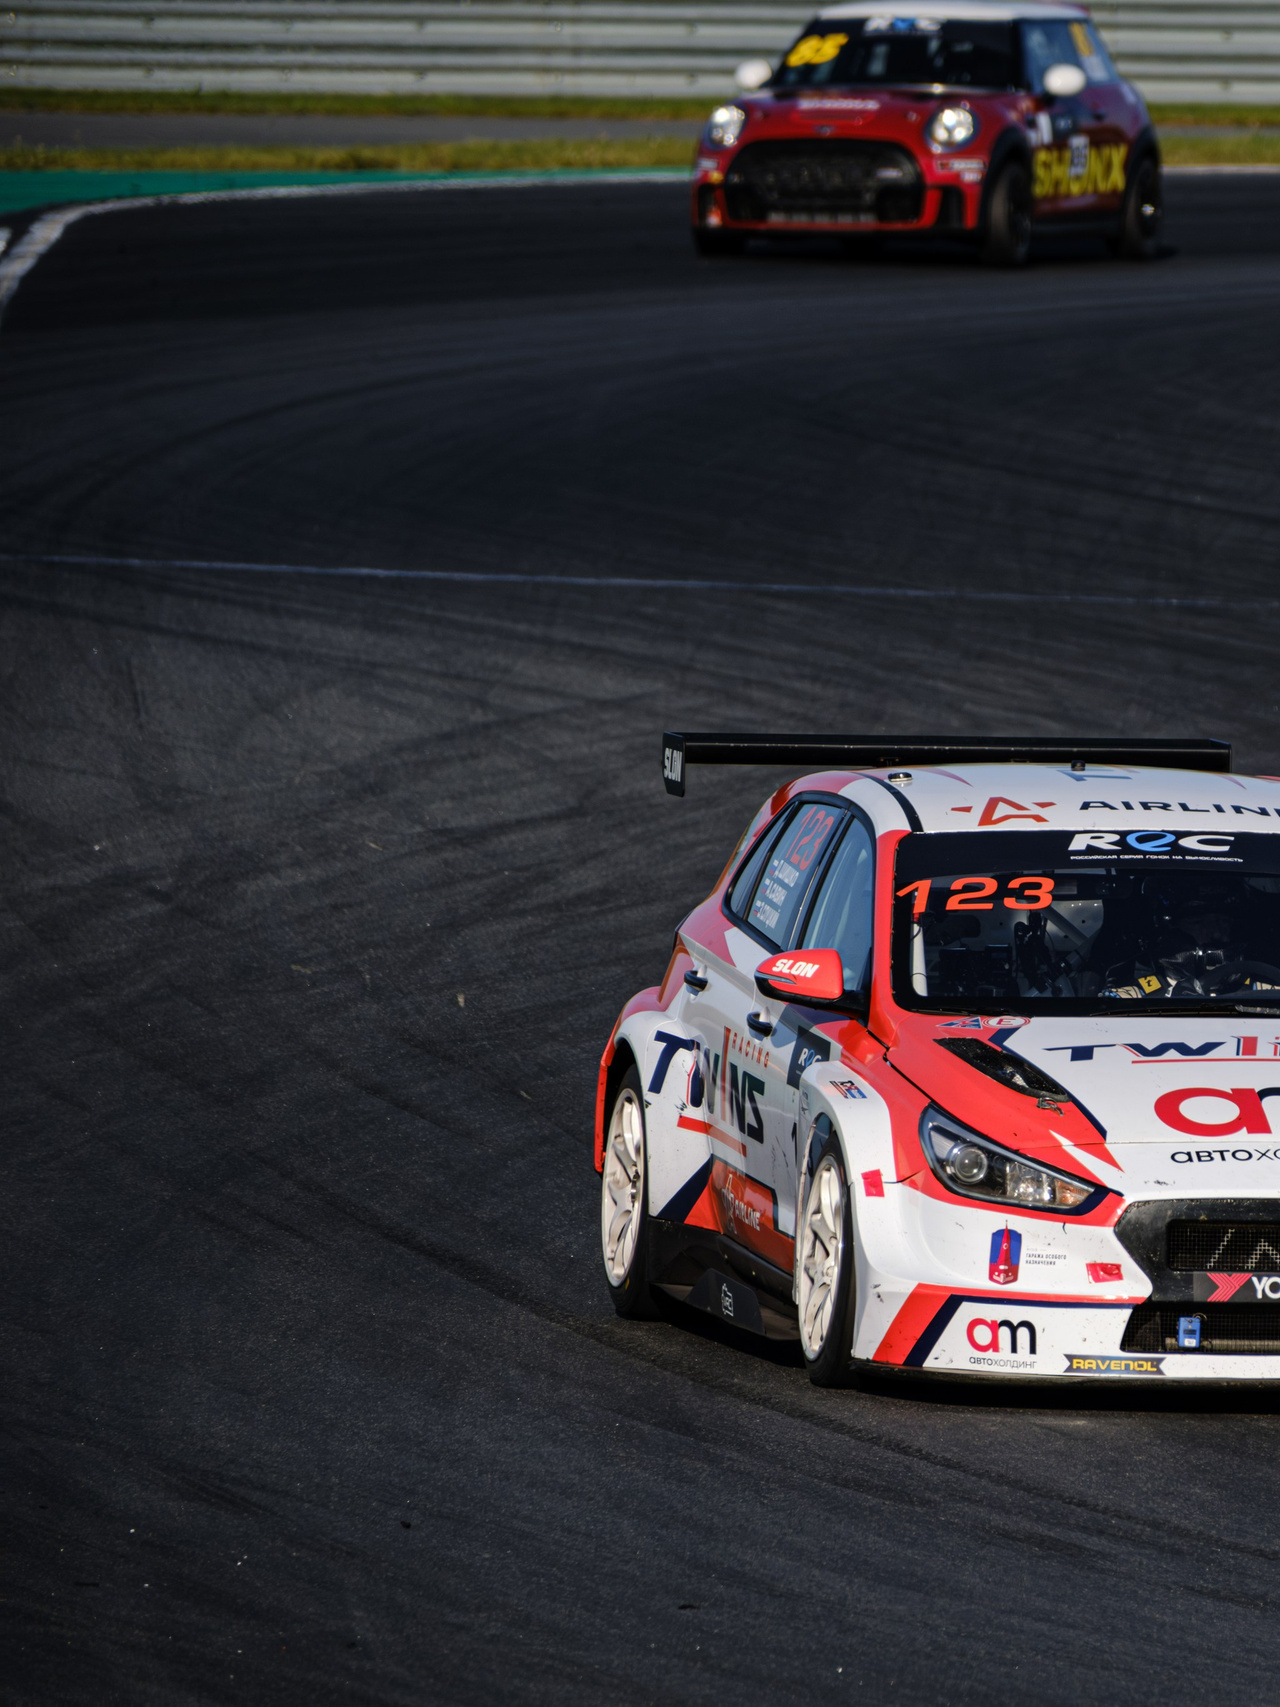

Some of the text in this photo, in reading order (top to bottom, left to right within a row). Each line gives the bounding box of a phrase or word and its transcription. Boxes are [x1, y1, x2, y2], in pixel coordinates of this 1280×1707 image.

[663, 747, 682, 782] SLON
[785, 806, 834, 870] 123
[895, 877, 1055, 914] 123
[772, 958, 820, 978] SLON
[731, 1032, 770, 1069] RACING
[648, 1029, 766, 1145] TWINS
[735, 1199, 761, 1232] AIRLINE
[966, 1317, 1037, 1355] am
[969, 1356, 1037, 1369] автохолдинг
[1072, 1359, 1157, 1372] RAVENOL
